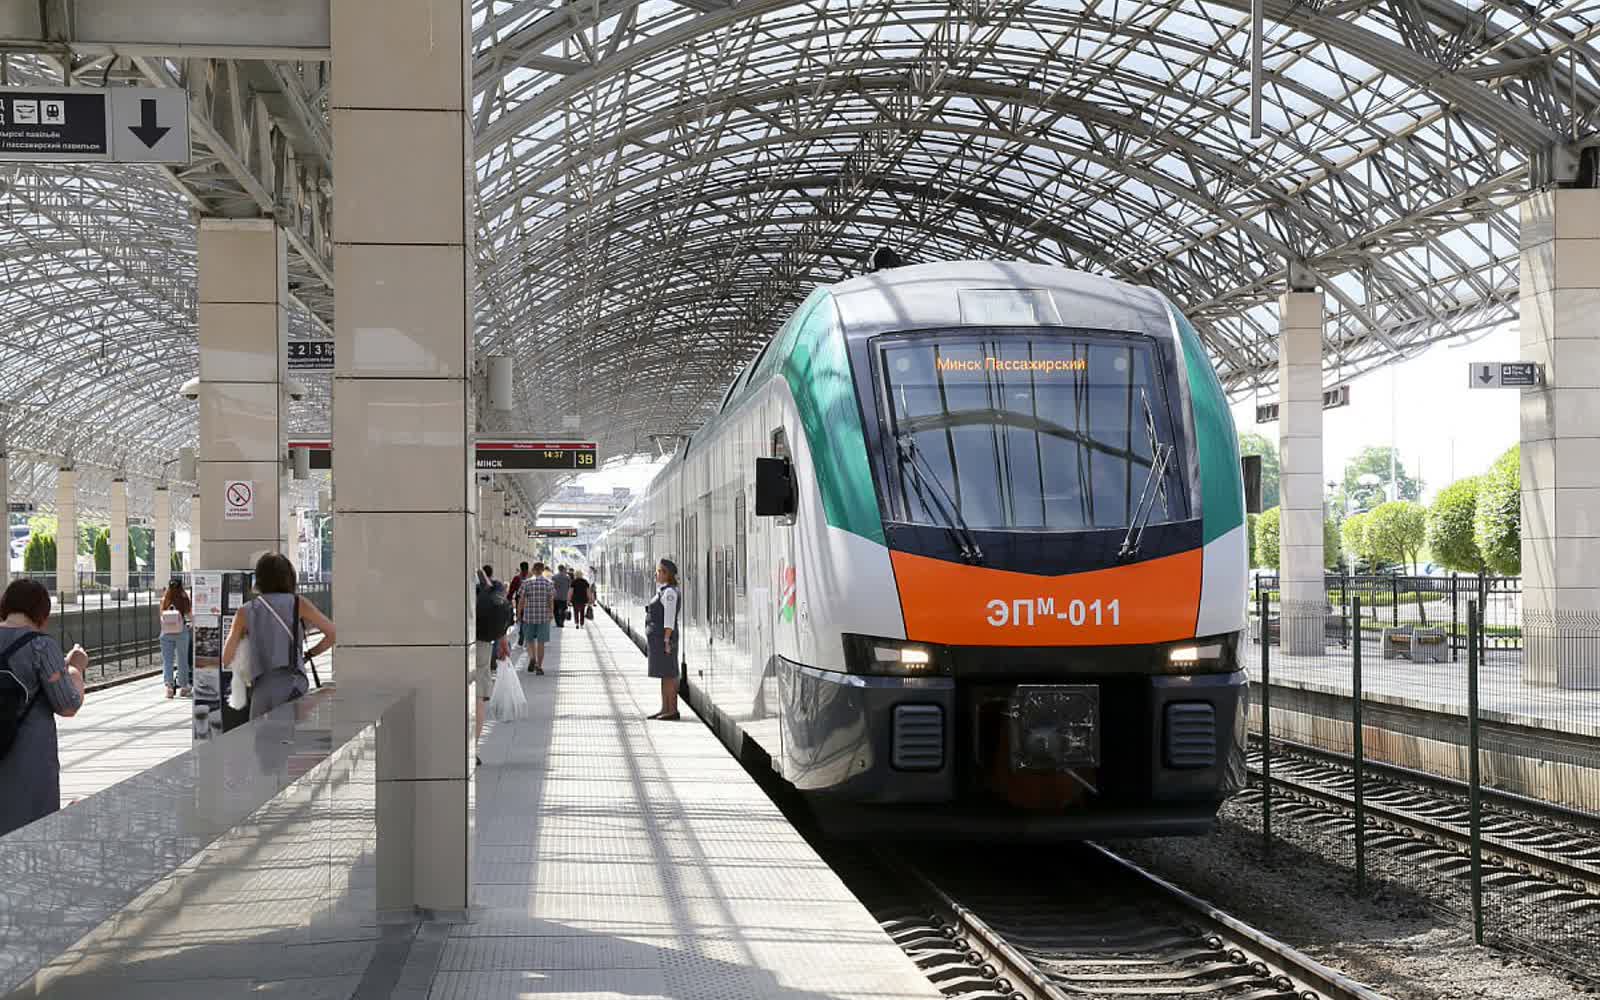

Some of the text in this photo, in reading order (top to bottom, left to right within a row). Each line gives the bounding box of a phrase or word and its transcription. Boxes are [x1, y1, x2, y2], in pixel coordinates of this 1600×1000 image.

[6, 141, 61, 150] пассажирский
[298, 345, 305, 355] 2
[314, 345, 321, 355] 3
[937, 357, 1086, 373] Минск Пассажирский
